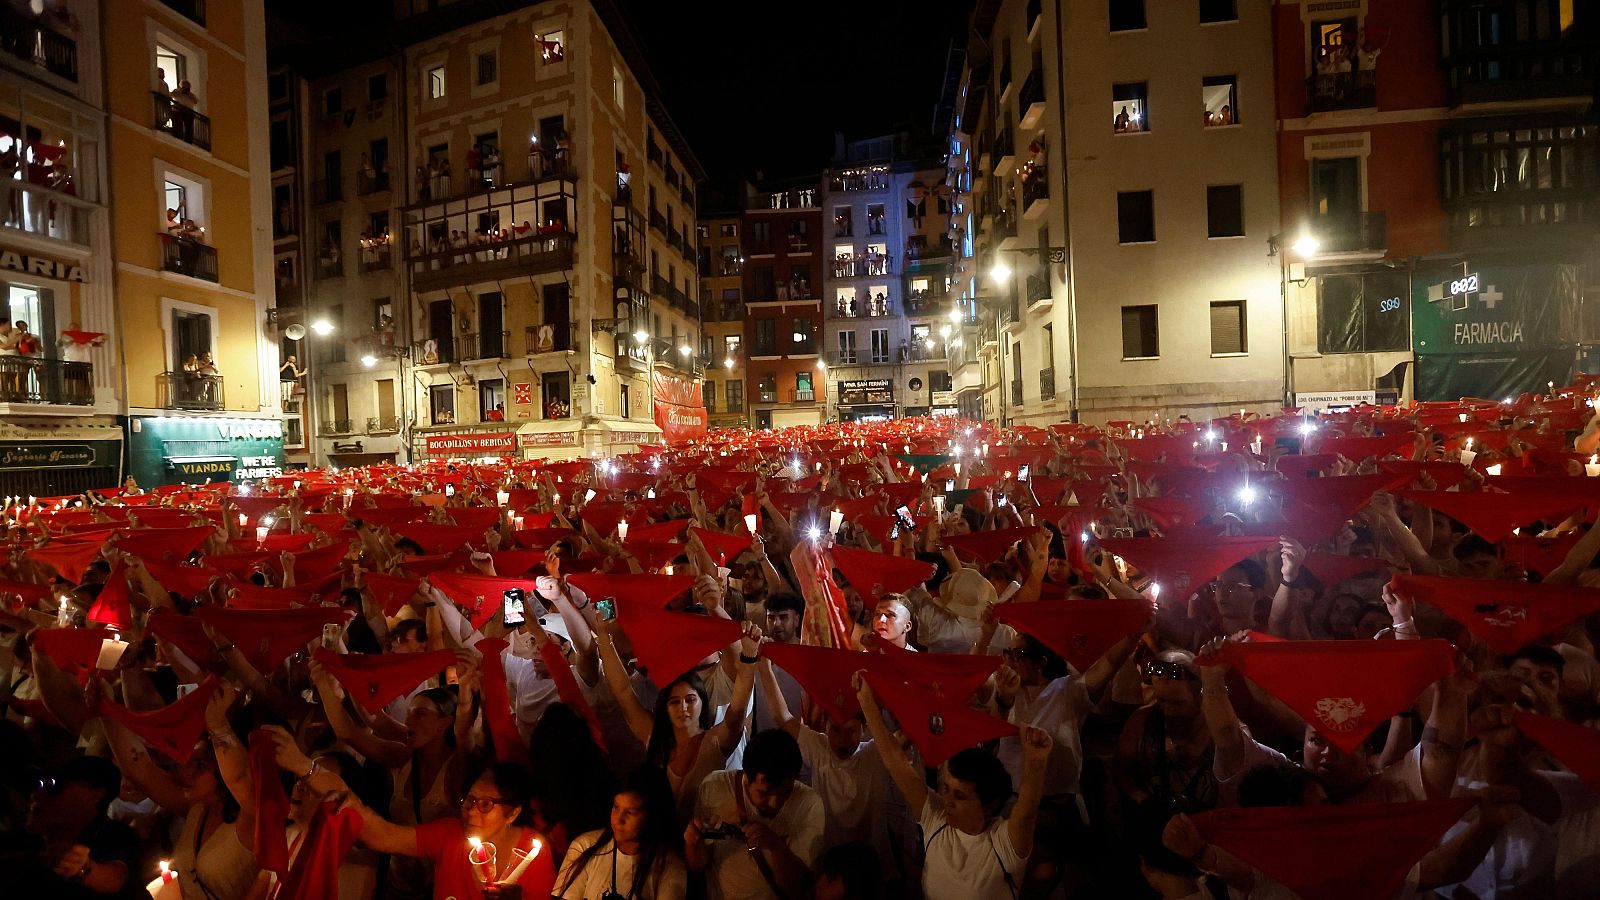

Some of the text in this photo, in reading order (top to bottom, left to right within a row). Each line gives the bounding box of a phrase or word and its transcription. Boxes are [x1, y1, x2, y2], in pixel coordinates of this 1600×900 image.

[1454, 321, 1523, 345] FARMACIA
[429, 440, 472, 449] BOCADILLOS
[480, 438, 512, 447] BEBIDAS
[182, 463, 231, 474] VIANDAS
[235, 467, 283, 479] FARMERS
